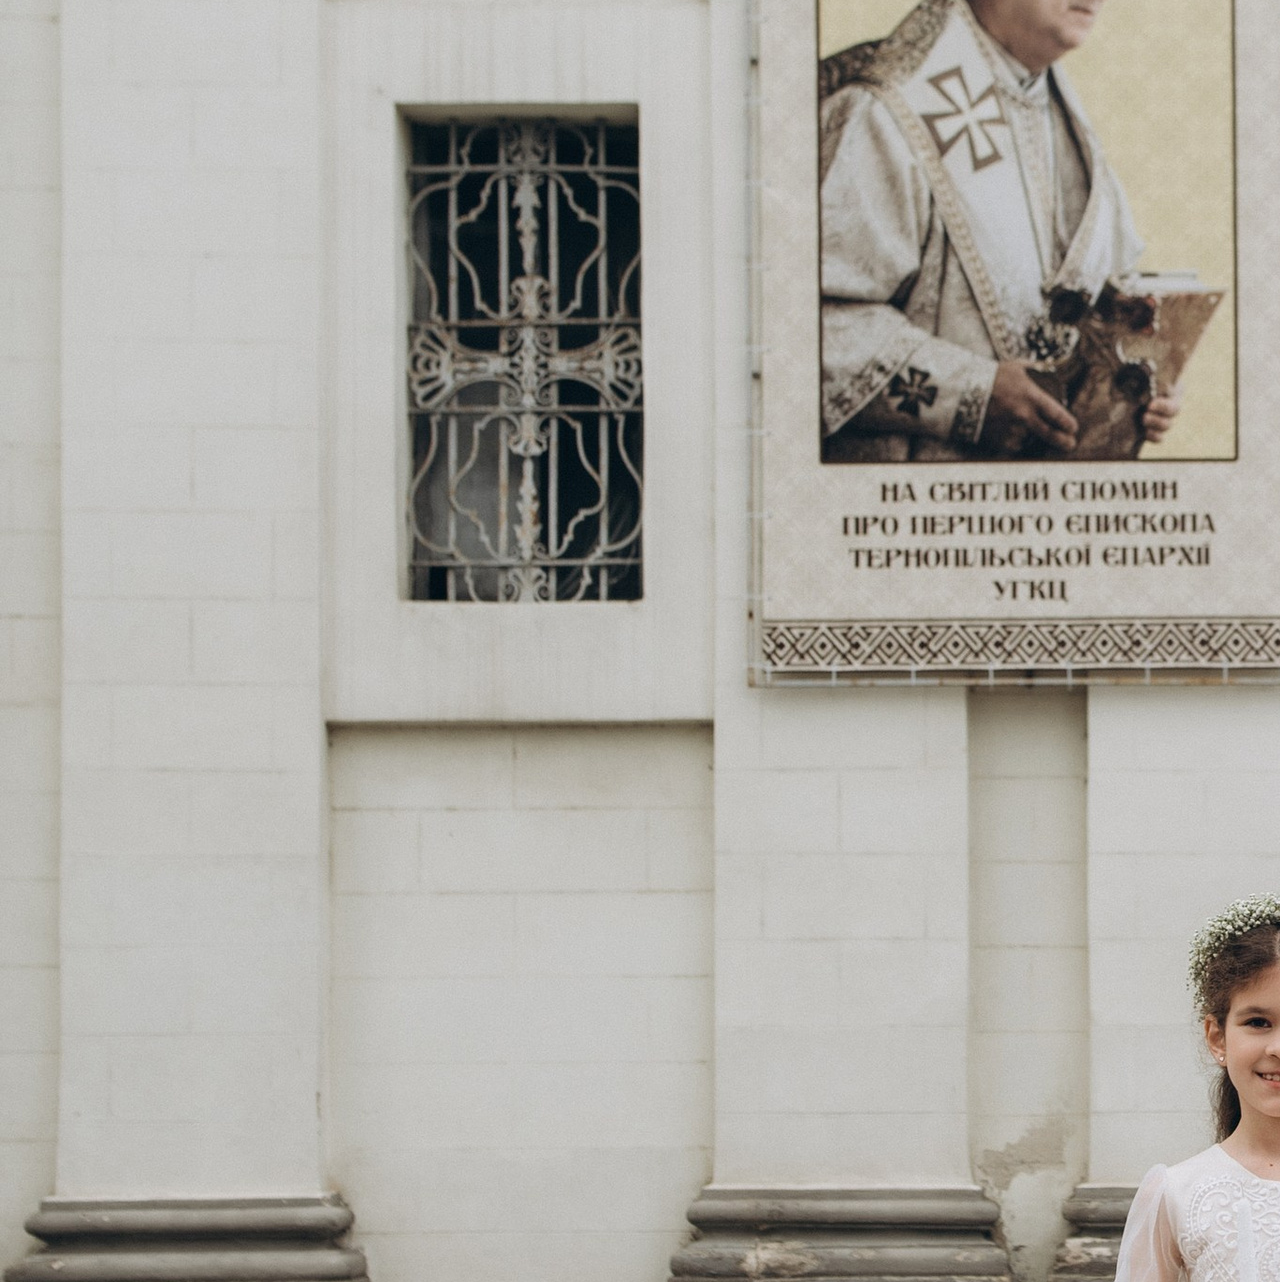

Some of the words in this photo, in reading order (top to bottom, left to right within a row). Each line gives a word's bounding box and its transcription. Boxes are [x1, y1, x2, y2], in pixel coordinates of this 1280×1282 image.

[880, 481, 917, 503] НА
[927, 478, 1049, 503] СВІТЛИЙ
[1059, 479, 1178, 501] СПОМИН
[841, 514, 899, 536] ПРО
[909, 513, 1054, 536] ПЕРШОГО
[1064, 512, 1215, 535] ЄПИСКОПА
[848, 543, 1092, 569] ТЕРНОПІЛЬСЬКОЇ
[1101, 542, 1210, 567] ЄПАРХІЇ
[992, 579, 1068, 602] УГКЦ
